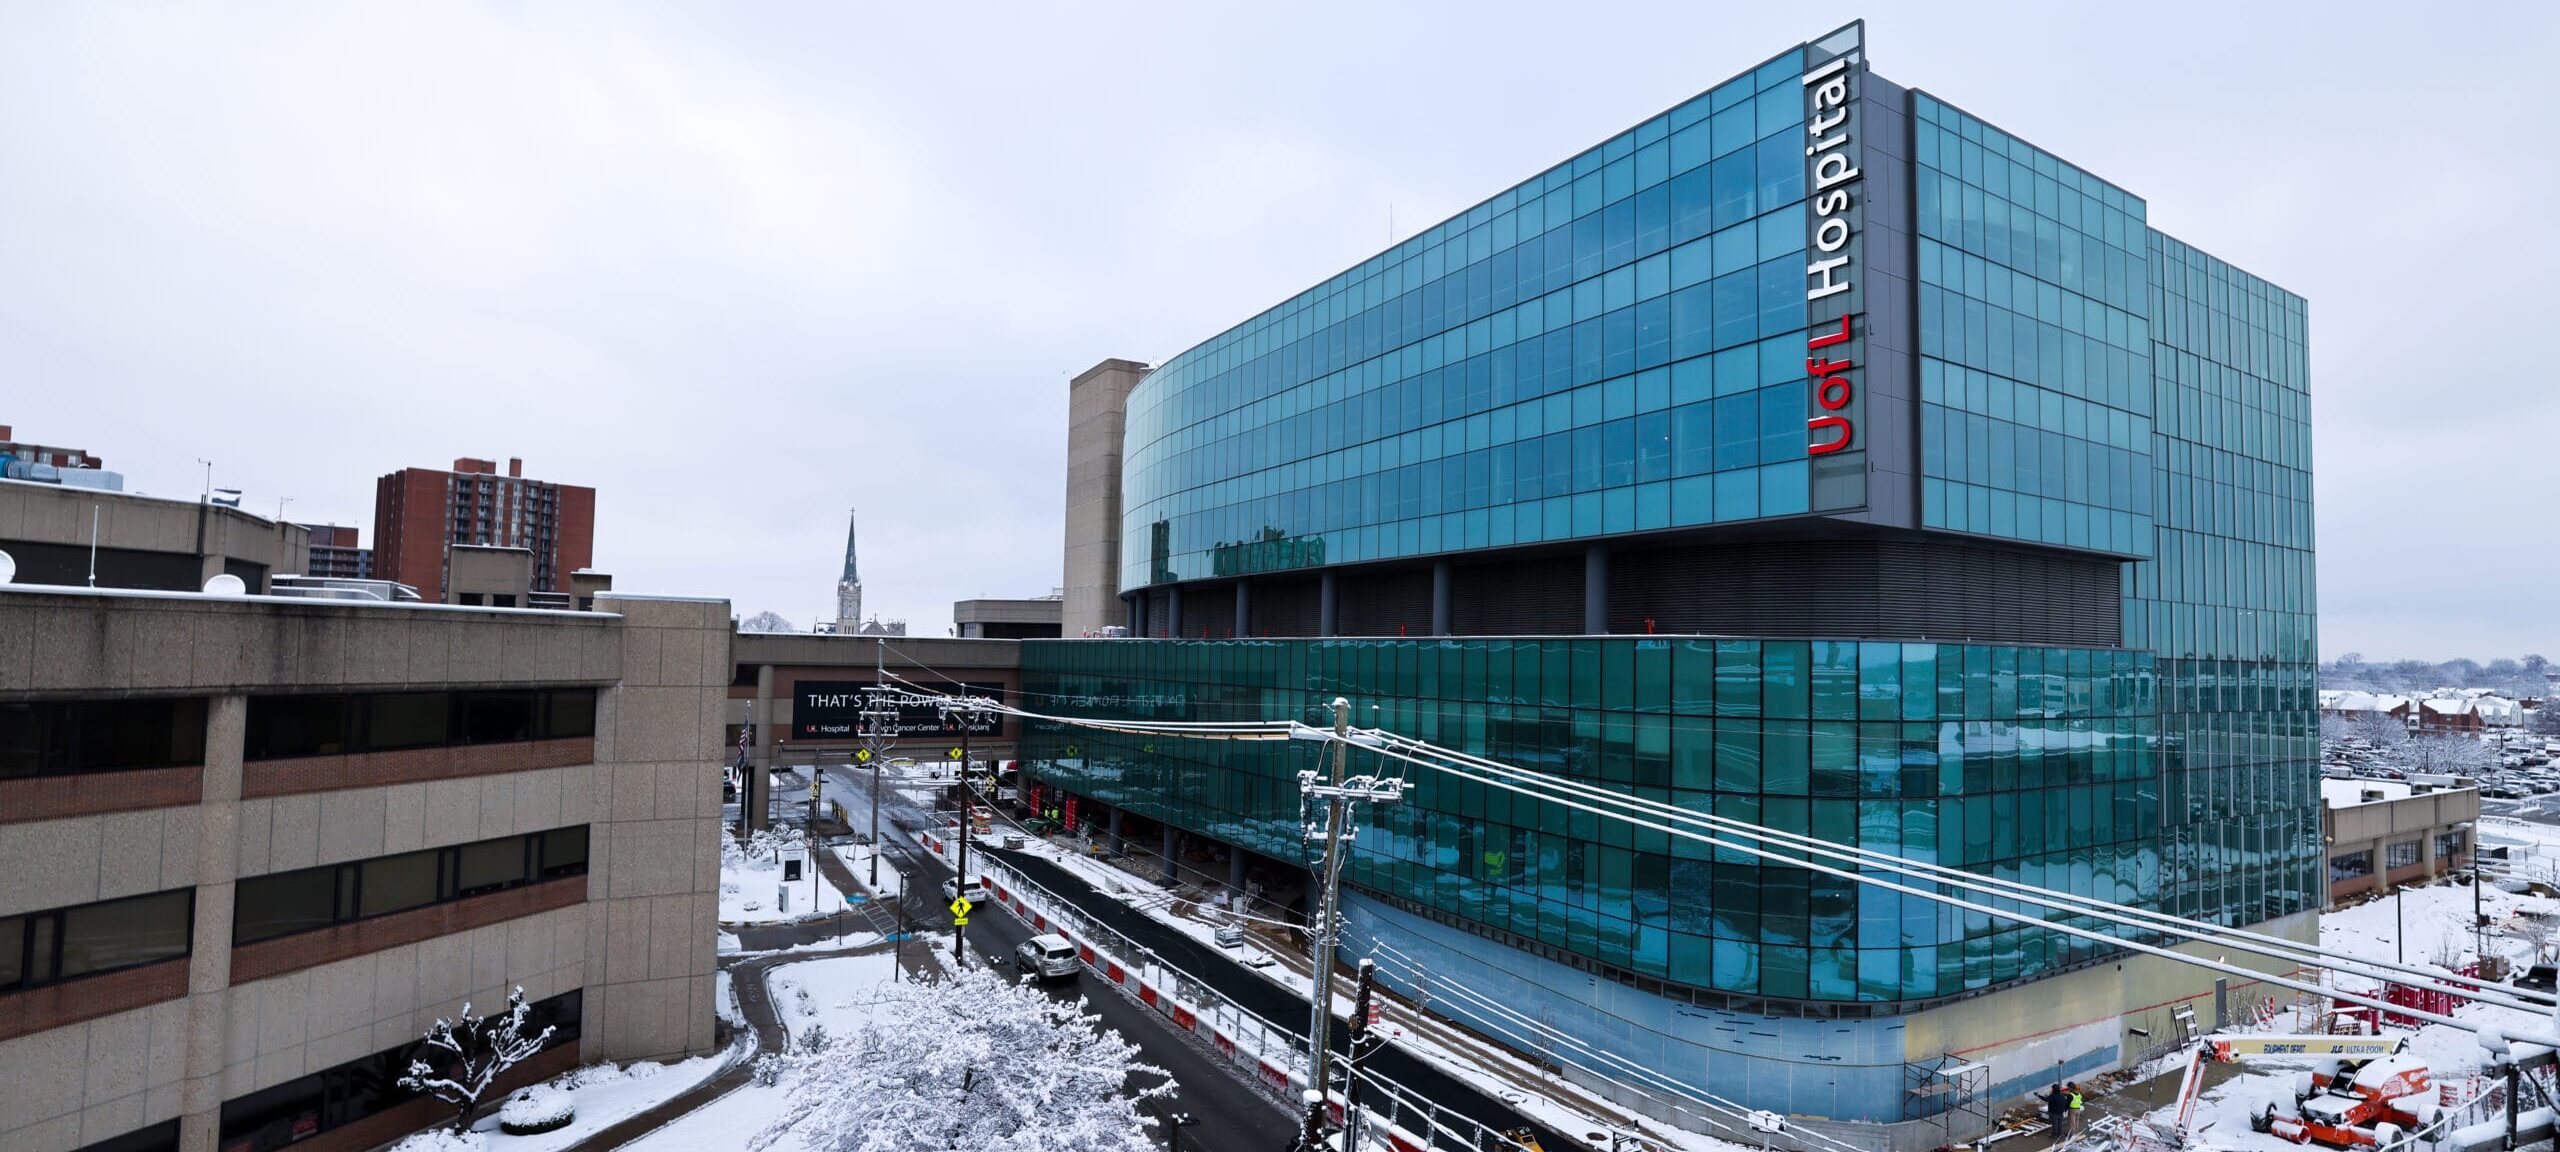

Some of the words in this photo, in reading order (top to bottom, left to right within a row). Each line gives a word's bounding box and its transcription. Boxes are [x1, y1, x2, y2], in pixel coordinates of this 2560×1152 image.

[1802, 58, 1860, 300] Hospital
[808, 694, 862, 708] THAT'S
[900, 694, 952, 708] POWE
[821, 724, 850, 734] Hospital
[869, 724, 892, 732] Brwn
[892, 723, 917, 732] Cancer
[917, 723, 940, 732] Center
[958, 723, 990, 732] Psicians
[2330, 1045, 2344, 1054] JLG
